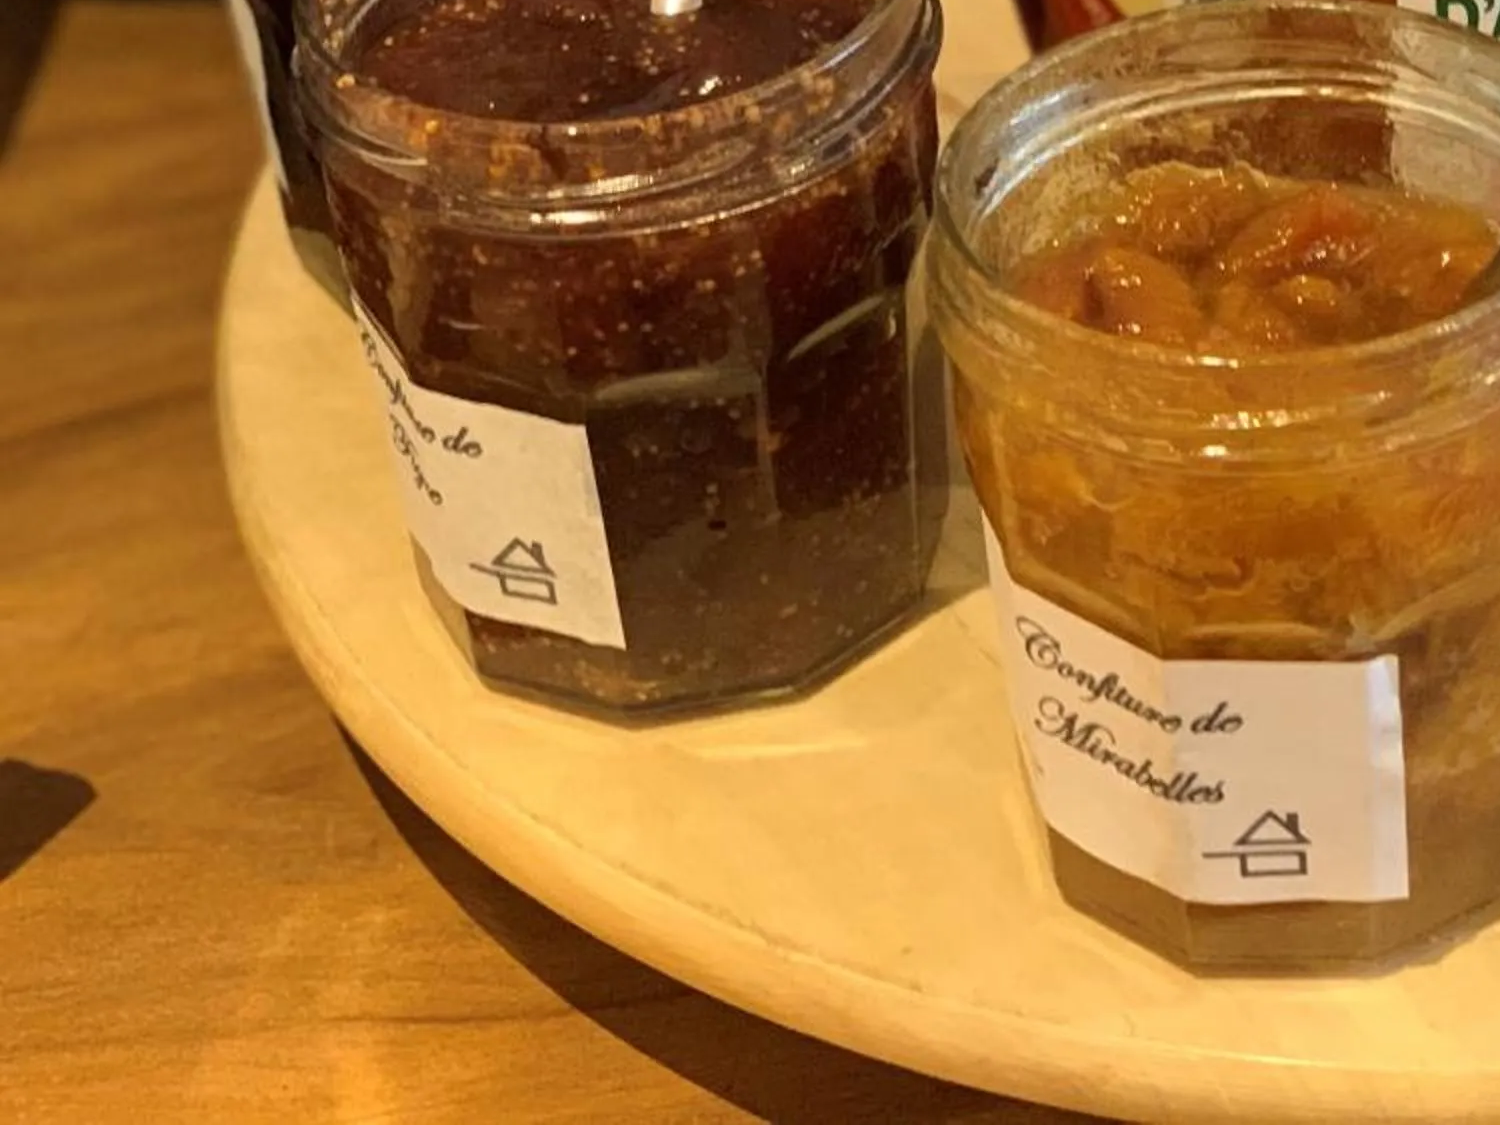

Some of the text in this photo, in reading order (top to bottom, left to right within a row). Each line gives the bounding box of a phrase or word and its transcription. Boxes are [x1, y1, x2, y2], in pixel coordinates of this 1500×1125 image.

[443, 426, 483, 459] de
[1015, 615, 1244, 735] Confiture de
[1033, 695, 1226, 805] Mirabelles
